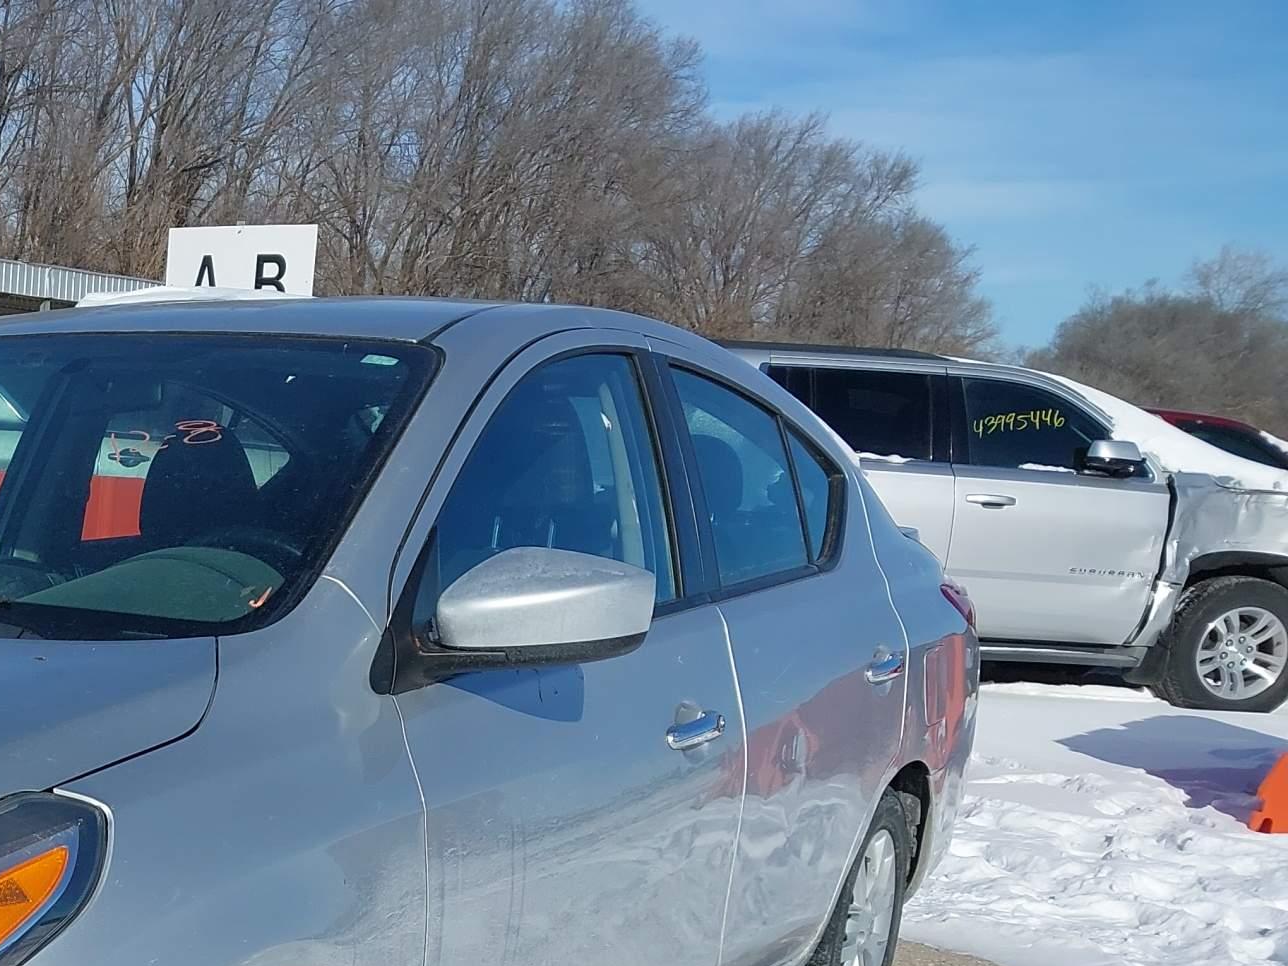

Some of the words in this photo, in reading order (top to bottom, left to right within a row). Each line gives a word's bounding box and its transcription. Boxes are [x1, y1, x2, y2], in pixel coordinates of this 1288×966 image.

[195, 254, 217, 288] A
[254, 253, 287, 293] B
[973, 408, 1065, 439] 43995446
[1068, 566, 1145, 579] SUBURBAN
